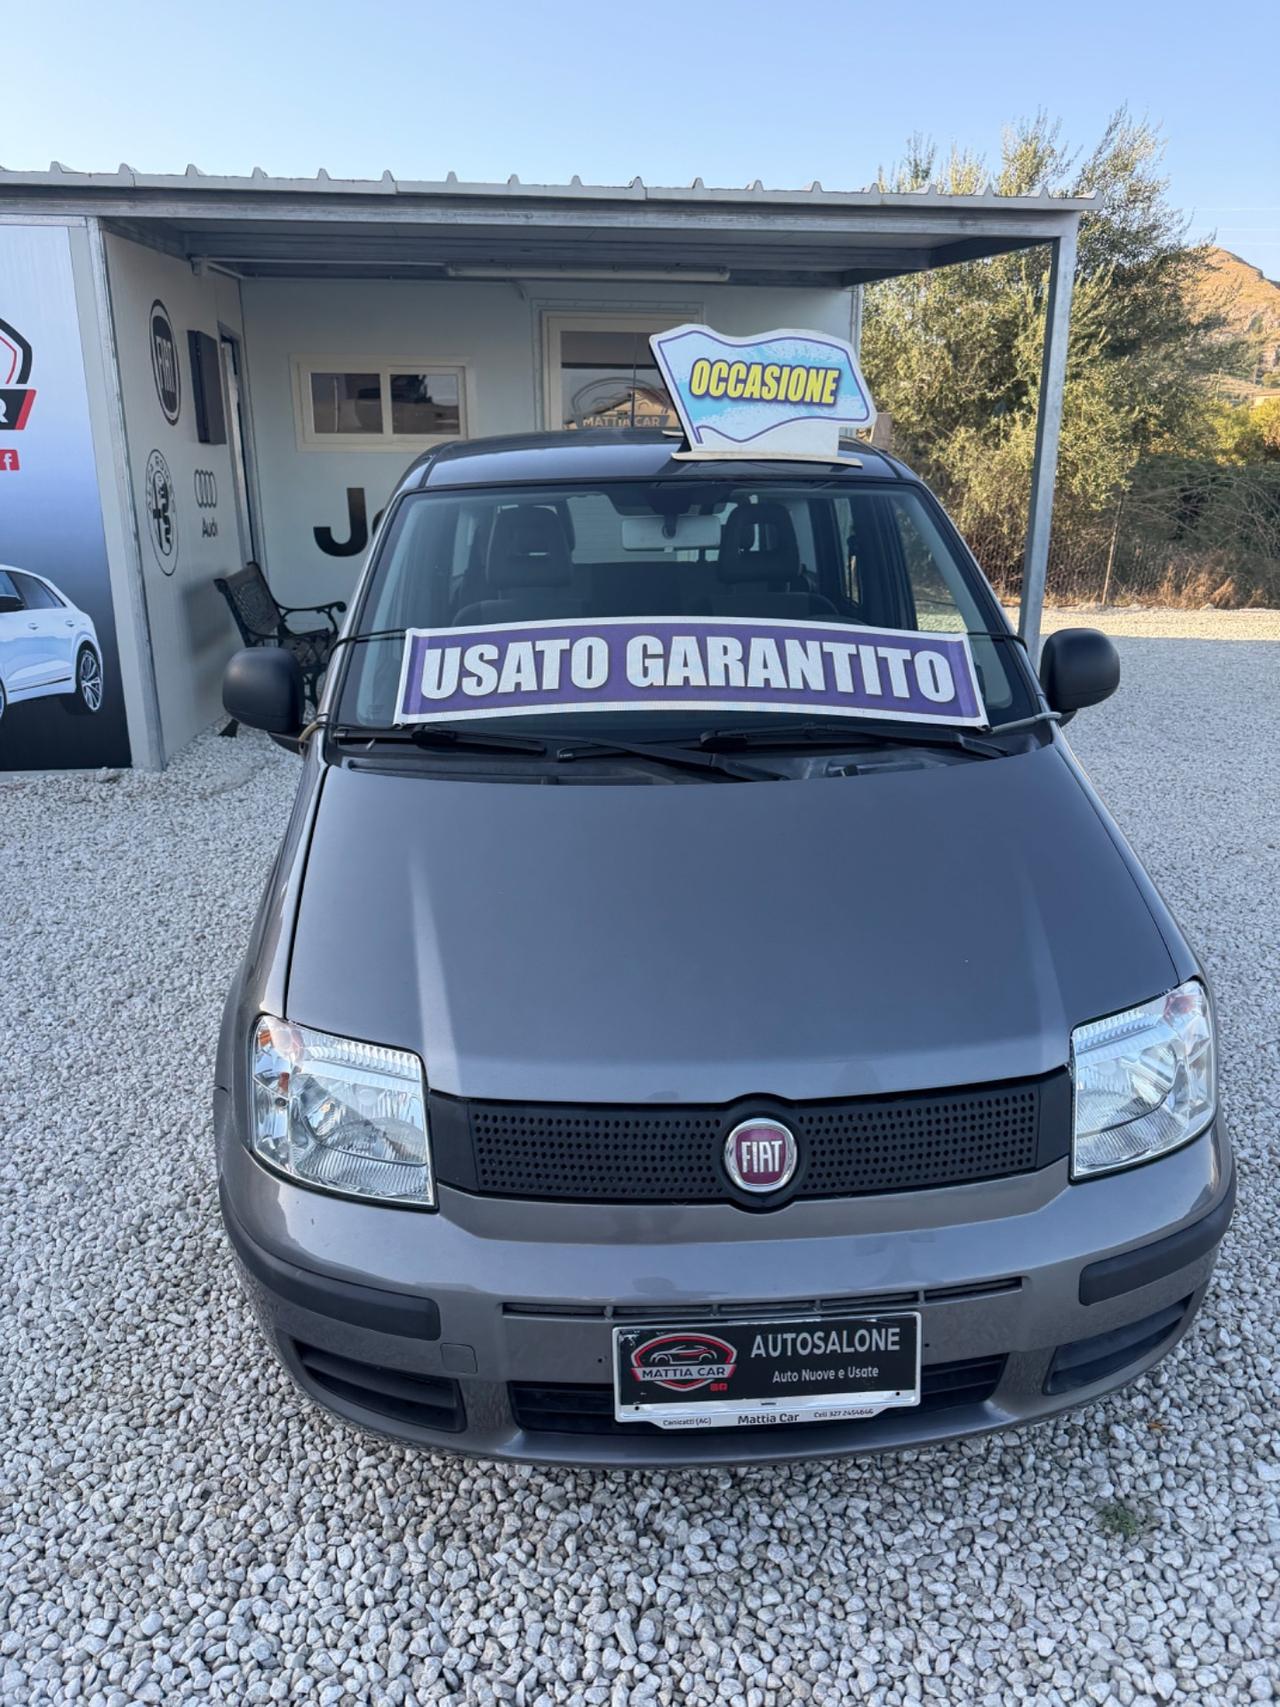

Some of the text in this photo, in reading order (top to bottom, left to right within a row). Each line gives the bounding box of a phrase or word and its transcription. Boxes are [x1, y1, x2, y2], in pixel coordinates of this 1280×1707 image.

[689, 358, 841, 406] OCCASIONE
[582, 416, 661, 427] MATTIA CAR
[201, 517, 219, 538] Audi
[313, 487, 385, 557] J
[420, 635, 956, 703] USATO GARANTITO
[741, 1140, 783, 1173] FIAT
[750, 1327, 901, 1359] AUTOSALONE
[642, 1366, 726, 1379] MATTIA CAR
[772, 1365, 880, 1384] Auto Nuove e Usate
[696, 1417, 712, 1426] (AG)
[737, 1412, 800, 1425] Mattia Car
